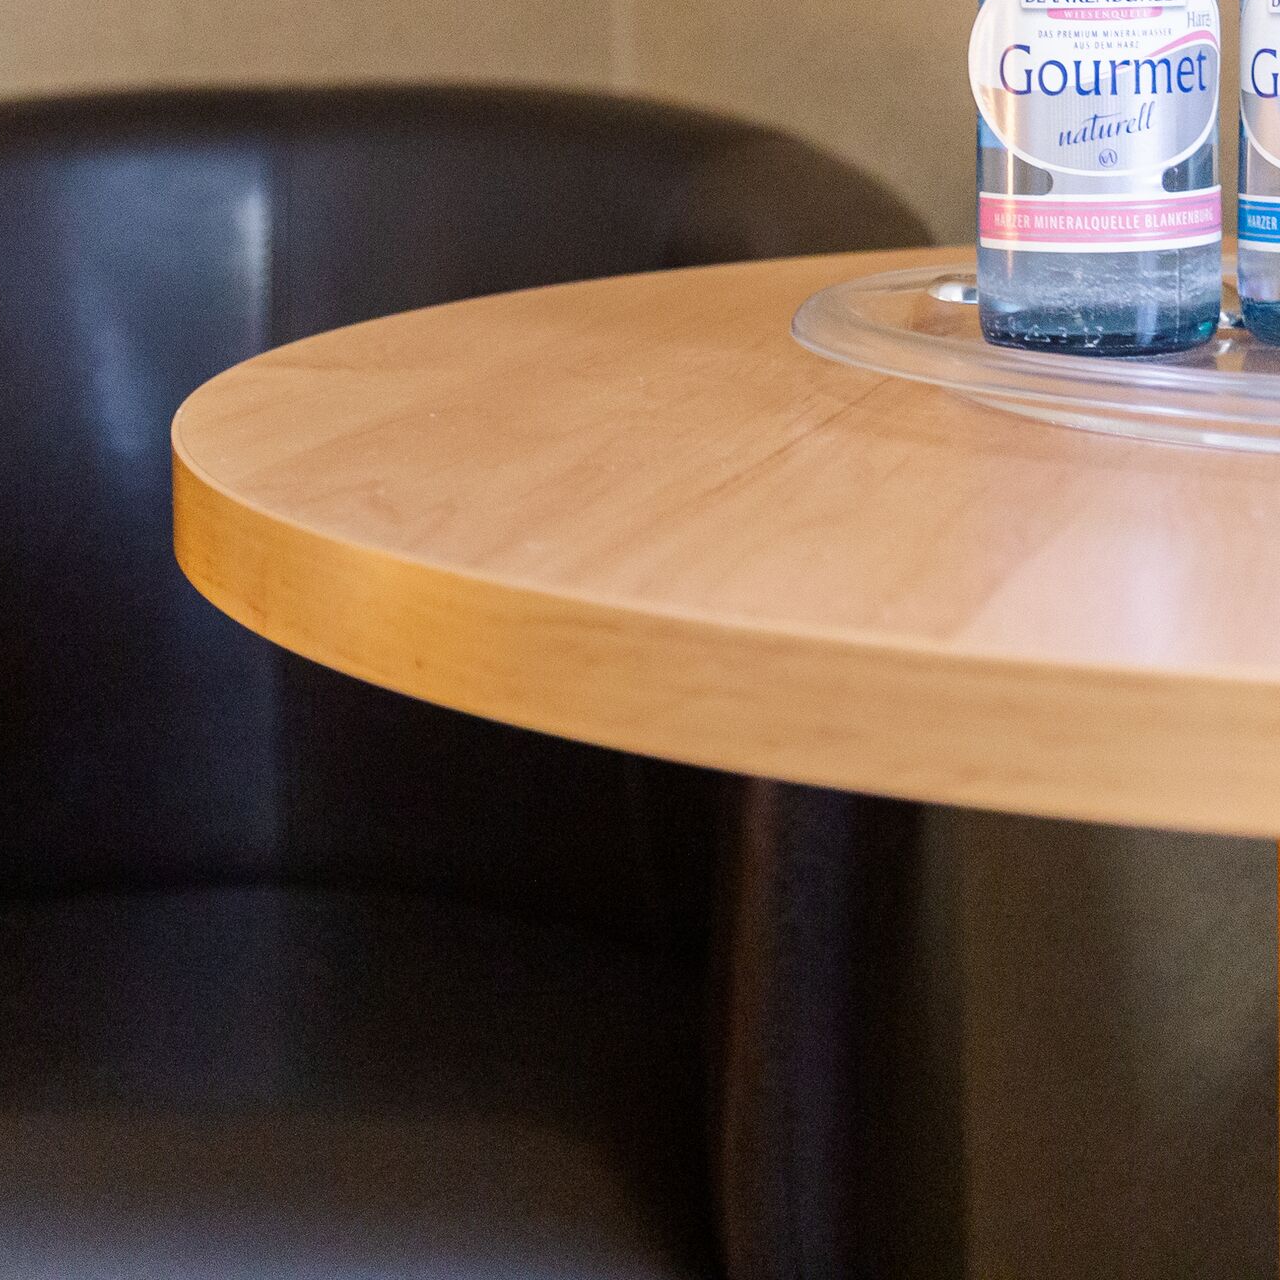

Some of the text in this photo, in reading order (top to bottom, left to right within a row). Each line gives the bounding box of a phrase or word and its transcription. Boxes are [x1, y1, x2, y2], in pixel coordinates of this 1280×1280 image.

[1063, 7, 1149, 20] WIESENQUELL
[1038, 27, 1173, 39] DAS PREMIUM MINERALWASSER
[1074, 40, 1140, 50] AUS DEM HARZ
[999, 43, 1207, 97] Gourmet
[1058, 100, 1155, 147] naturell
[993, 207, 1214, 232] HARZER MINERALQUELLE BLANKENBURG
[1246, 214, 1278, 231] HARZER
